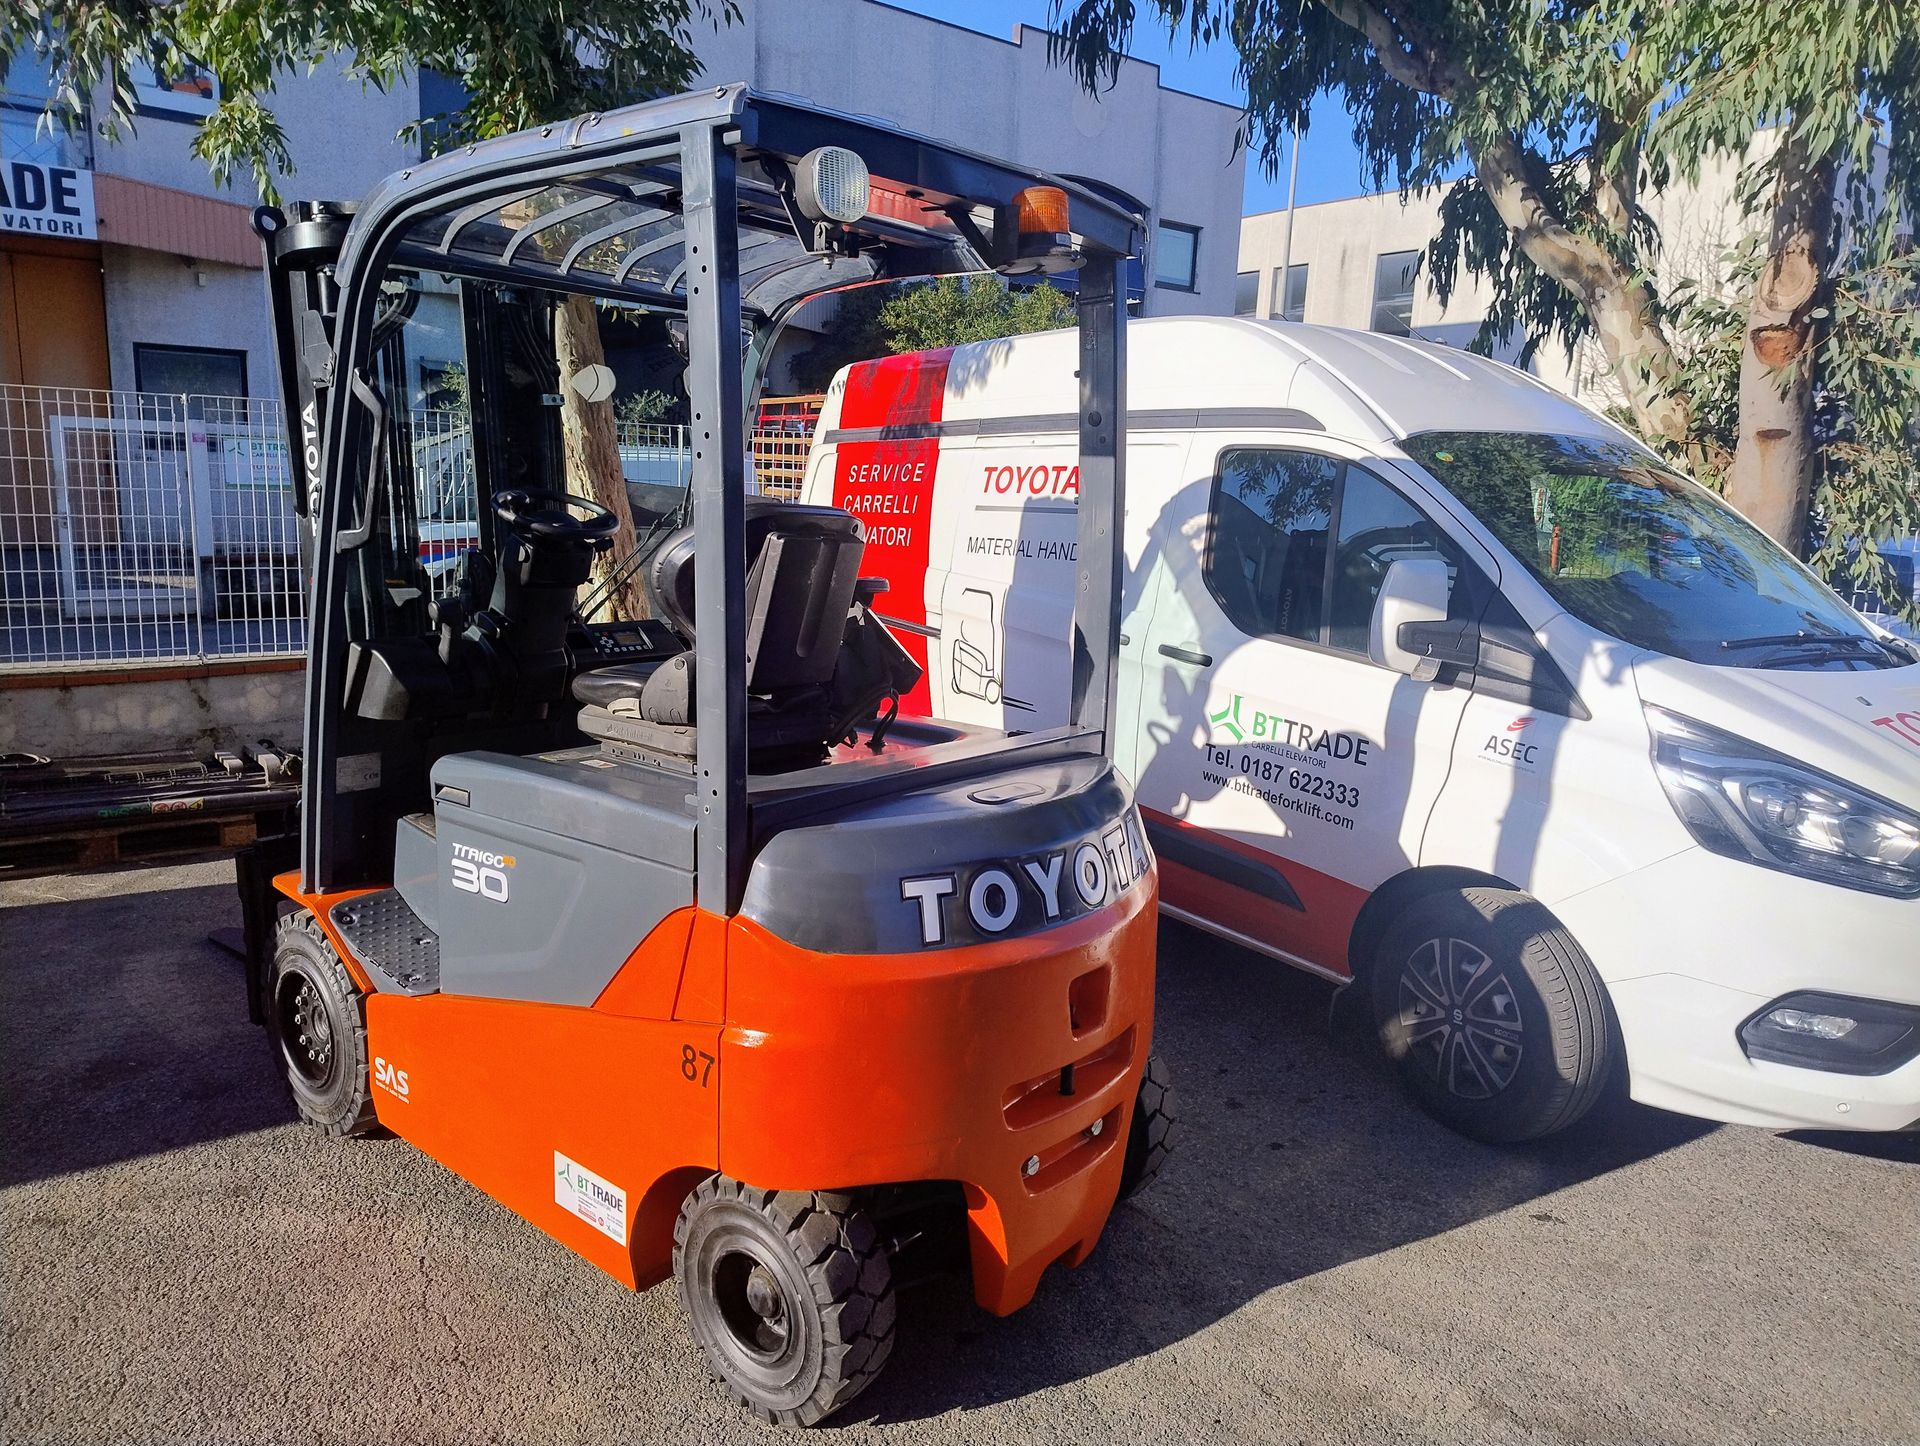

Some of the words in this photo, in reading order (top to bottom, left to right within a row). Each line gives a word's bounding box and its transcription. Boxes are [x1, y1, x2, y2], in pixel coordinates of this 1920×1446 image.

[302, 401, 320, 537] TOYOTA
[848, 463, 925, 483] SERVICE
[983, 465, 1079, 495] TOYOTA
[843, 494, 918, 514] CARRELLI
[966, 536, 1033, 558] MATERIAL
[1251, 741, 1285, 757] CARRELLI
[1285, 750, 1327, 769] ELEVATORI
[1484, 735, 1539, 764] ASEC
[1205, 743, 1234, 769] Tel.
[1240, 754, 1284, 784] 0187
[1289, 769, 1361, 808] 622333
[1202, 770, 1355, 831] www.bttradeforklift.com
[451, 858, 509, 903] 30
[900, 816, 1150, 945] TOYOTA
[374, 1056, 409, 1096] SAS
[682, 1043, 715, 1089] 87
[577, 1174, 590, 1191] BT
[591, 1182, 623, 1213] TRADE
